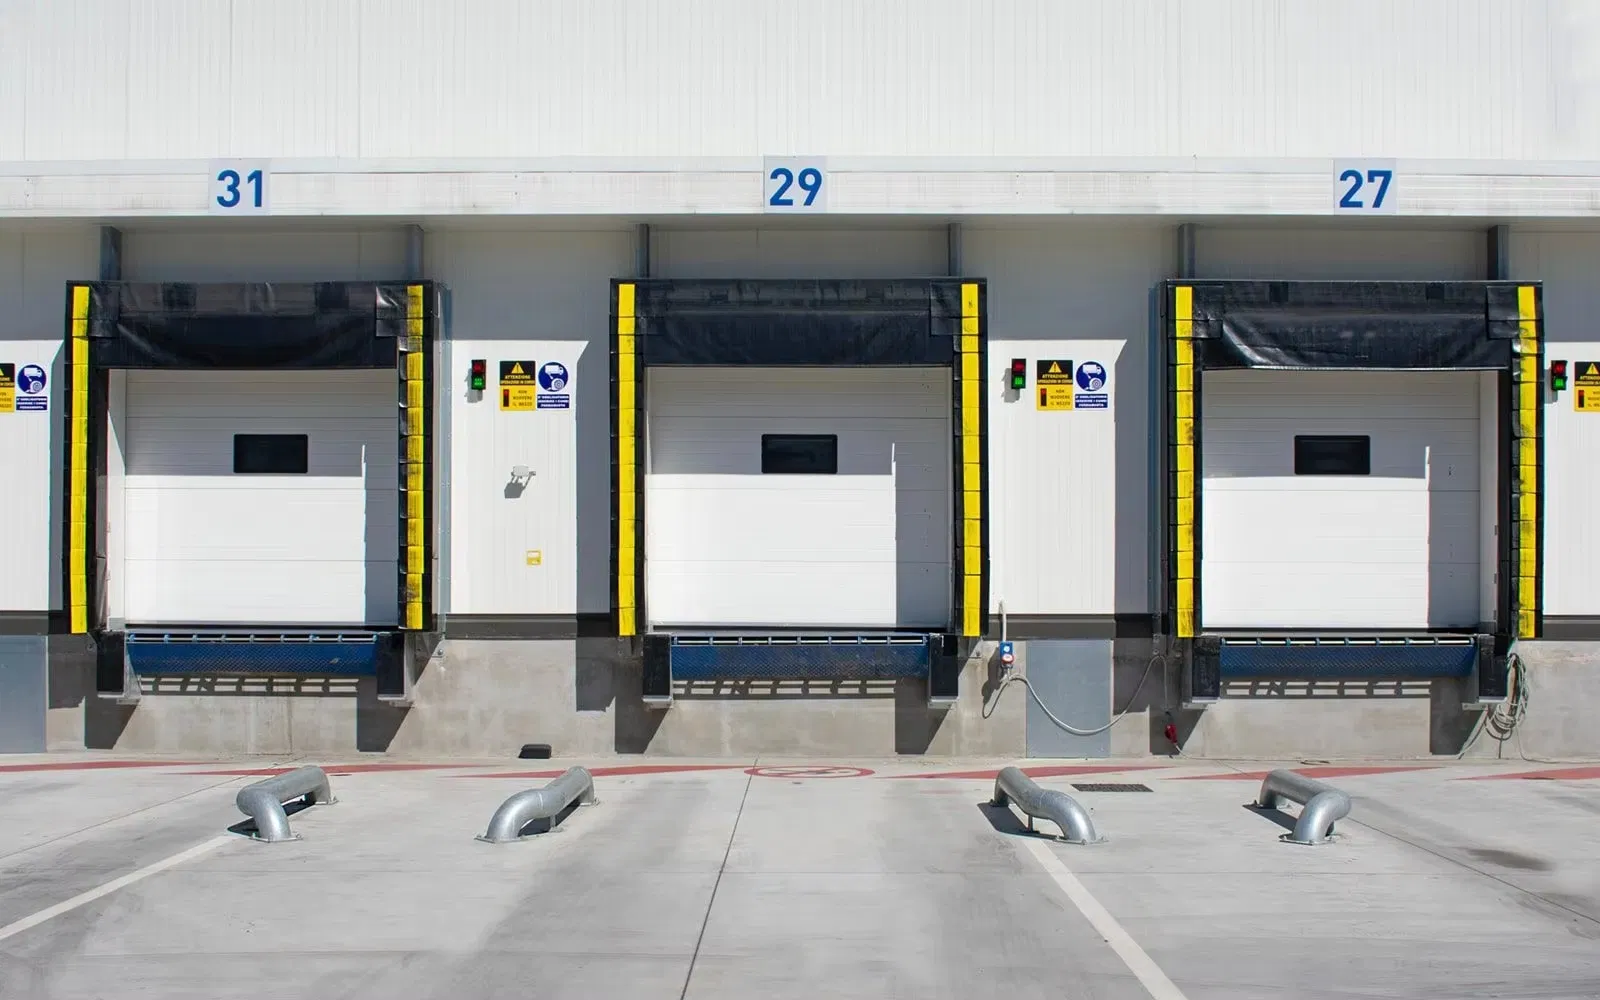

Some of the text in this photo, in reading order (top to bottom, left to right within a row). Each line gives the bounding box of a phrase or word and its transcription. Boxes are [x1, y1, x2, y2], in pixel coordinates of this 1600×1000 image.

[216, 169, 262, 208] 31
[769, 167, 822, 206] 29
[1339, 169, 1393, 208] 27
